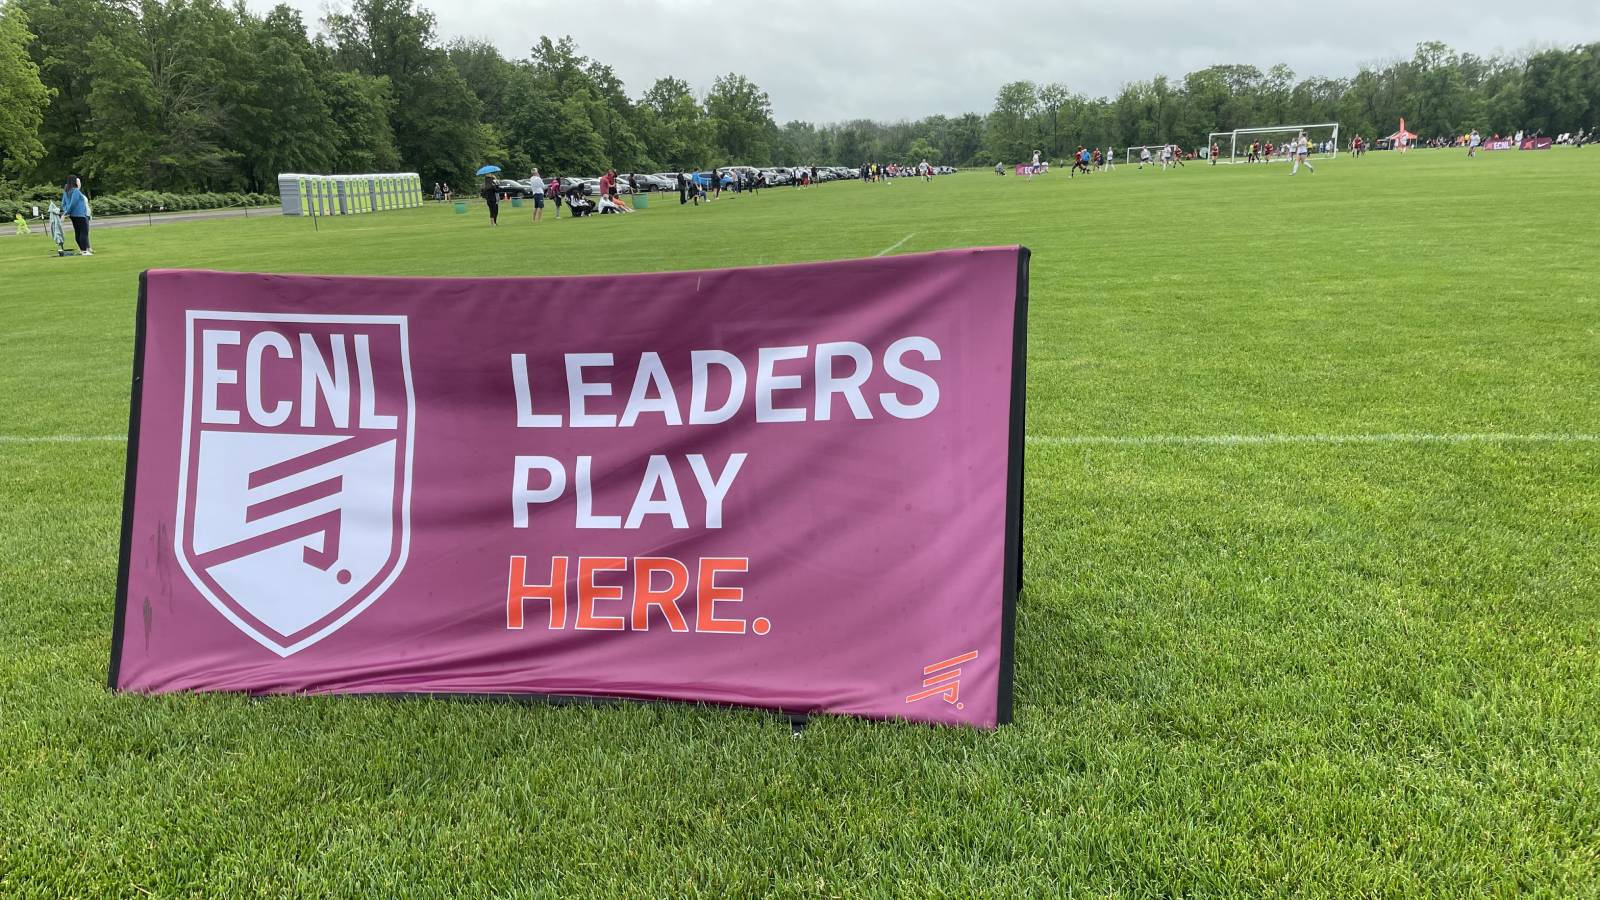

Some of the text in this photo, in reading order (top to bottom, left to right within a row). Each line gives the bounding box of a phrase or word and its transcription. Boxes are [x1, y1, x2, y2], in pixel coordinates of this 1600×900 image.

[200, 329, 399, 431] ECNL
[510, 335, 942, 429] LEADERS
[510, 452, 749, 531] PLAY
[506, 555, 772, 637] HERE.
